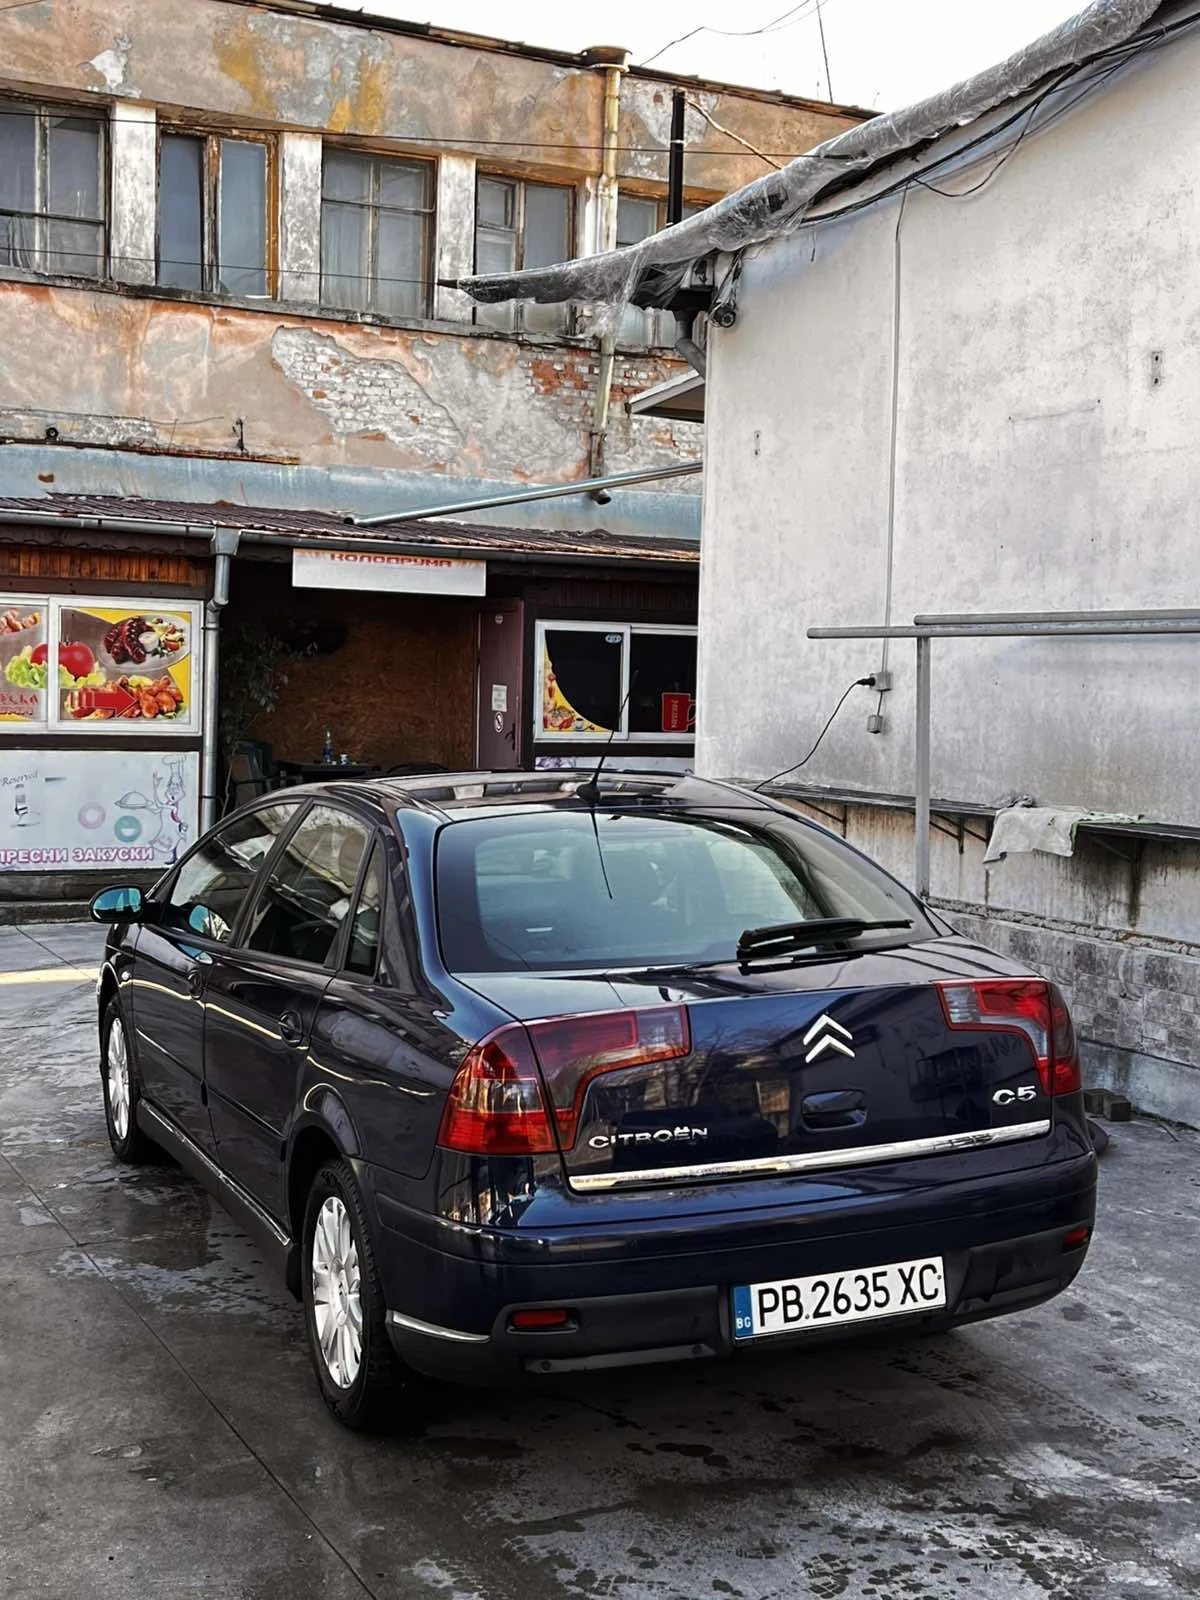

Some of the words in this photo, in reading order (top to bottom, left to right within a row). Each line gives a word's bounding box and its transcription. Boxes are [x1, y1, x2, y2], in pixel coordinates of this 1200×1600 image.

[72, 846, 154, 862] ЗАКУСКИ
[992, 1085, 1037, 1105] C5
[588, 1126, 708, 1148] CITROËN
[811, 1271, 890, 1319] 2635
[735, 1316, 751, 1329] BG
